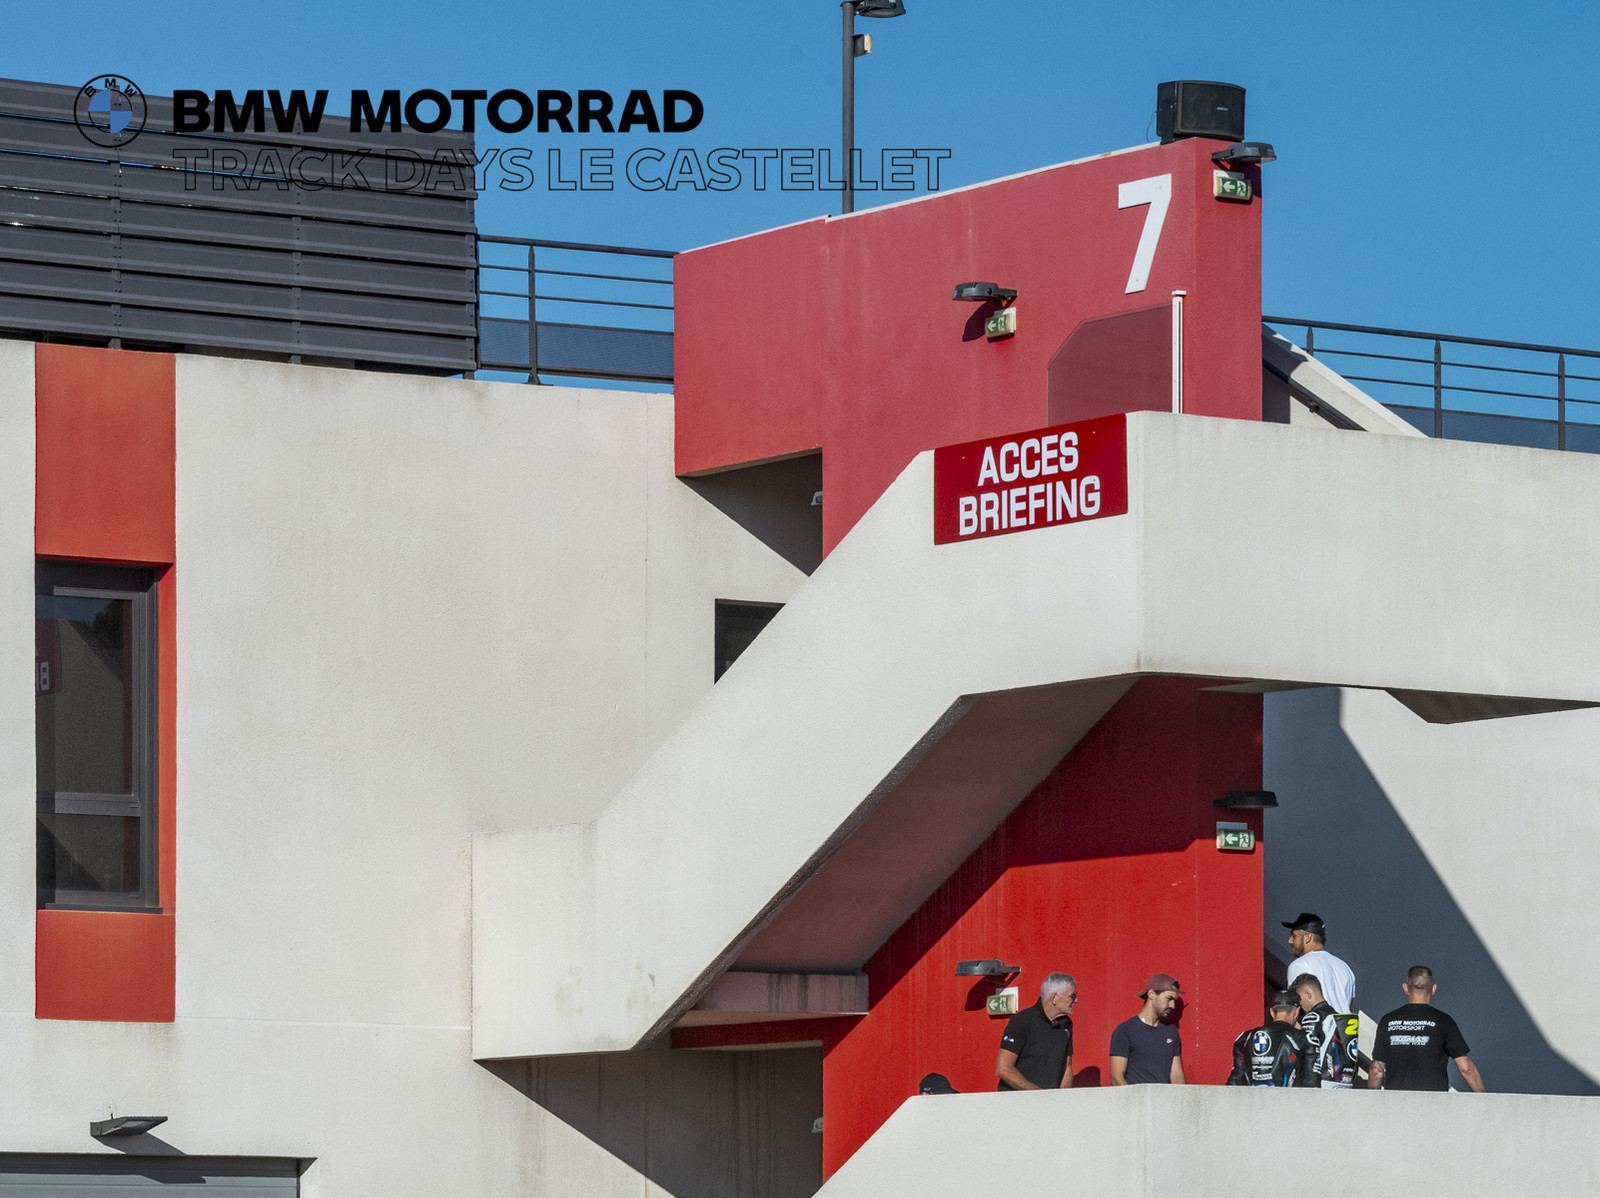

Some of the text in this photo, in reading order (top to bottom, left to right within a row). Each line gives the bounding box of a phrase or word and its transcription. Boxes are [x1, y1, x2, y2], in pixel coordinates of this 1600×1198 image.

[1117, 173, 1172, 294] 7
[977, 431, 1079, 487] ACCES
[959, 474, 1101, 536] BRIEFING
